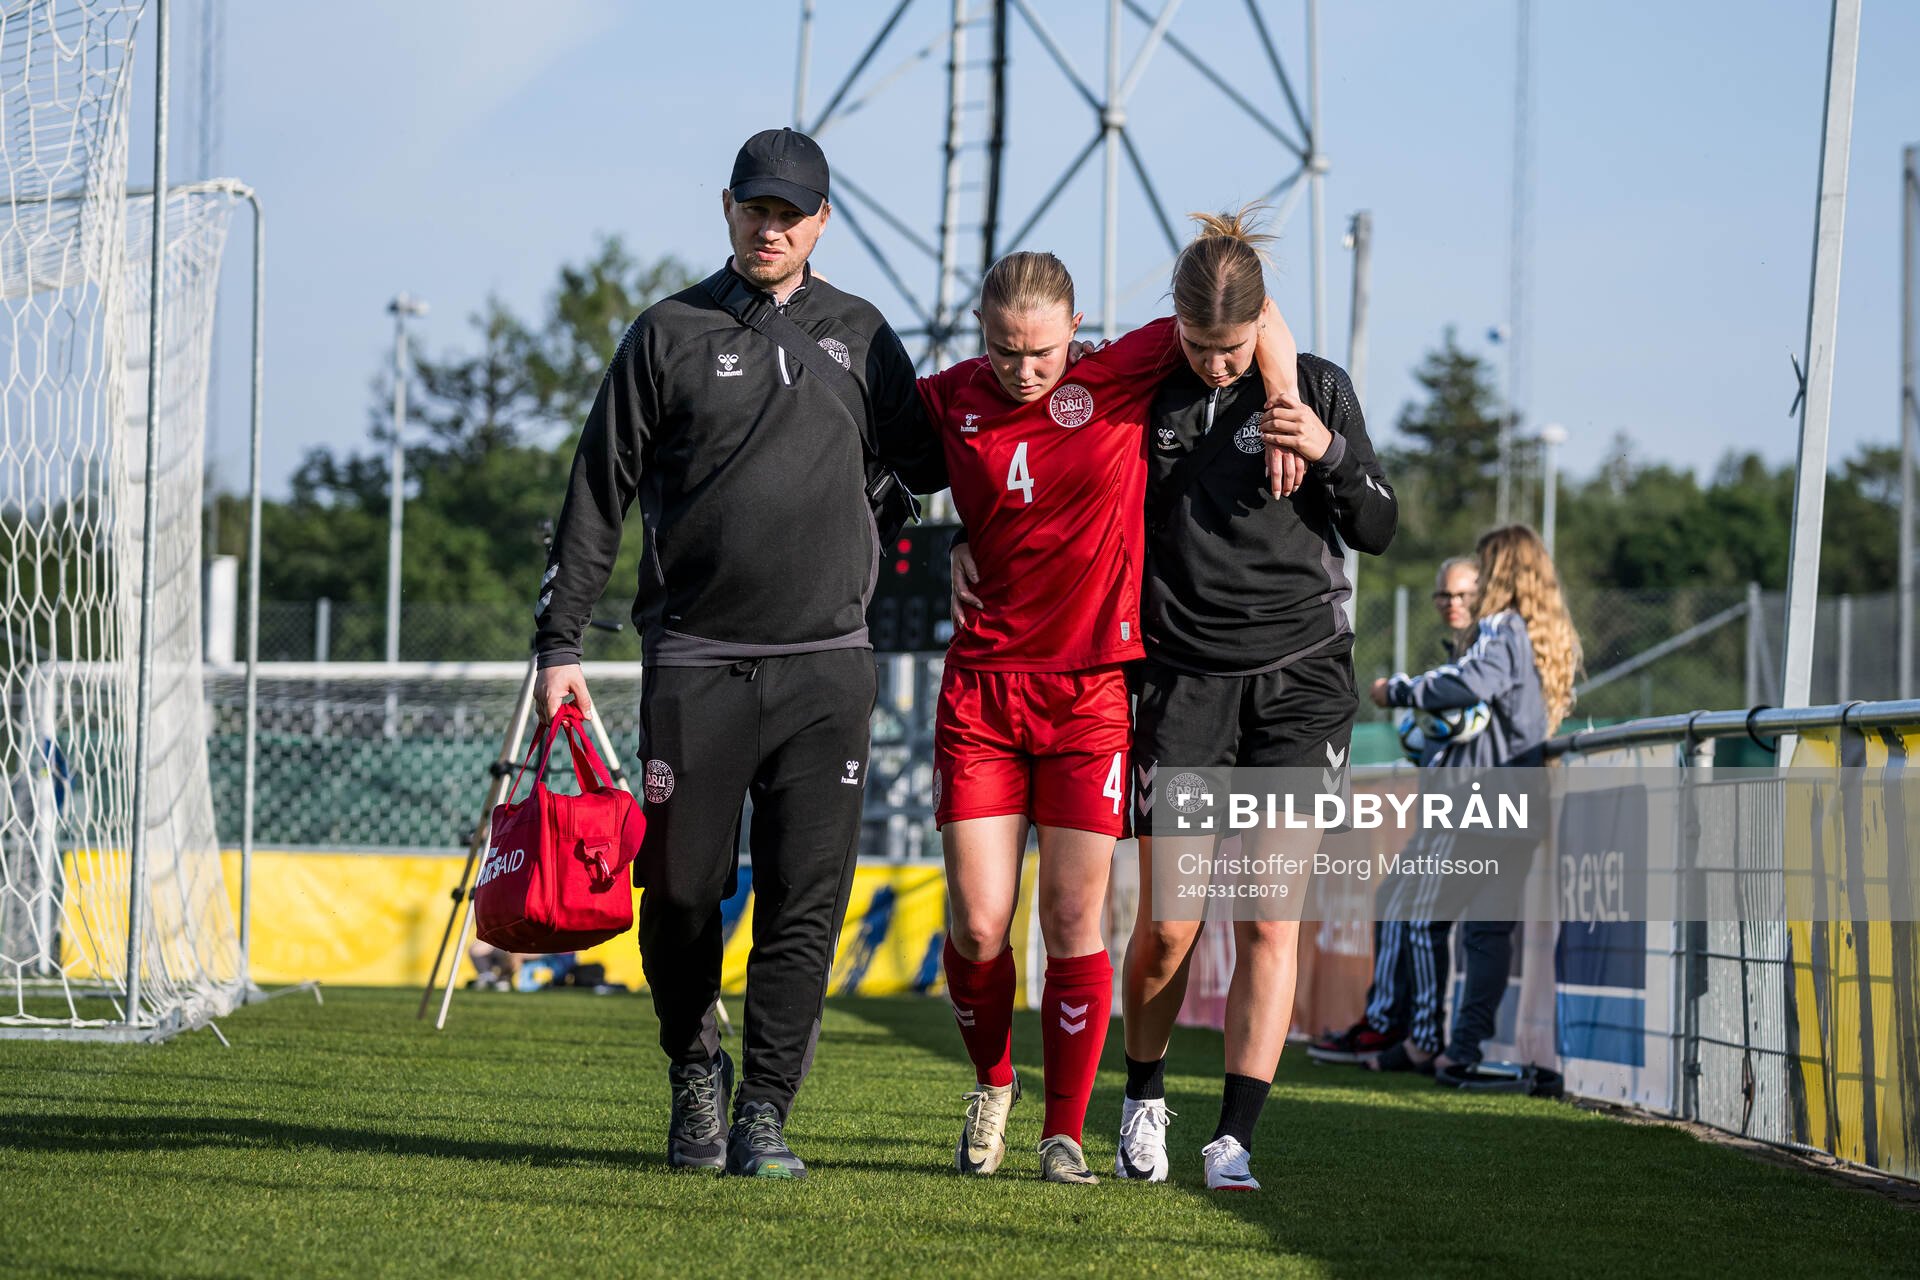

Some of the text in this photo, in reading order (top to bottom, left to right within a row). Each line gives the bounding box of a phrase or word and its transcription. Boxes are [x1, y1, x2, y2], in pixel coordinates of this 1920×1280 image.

[716, 369, 743, 377] hummel
[1060, 398, 1084, 413] DBU
[1007, 442, 1034, 503] 4
[1103, 752, 1123, 815] 4
